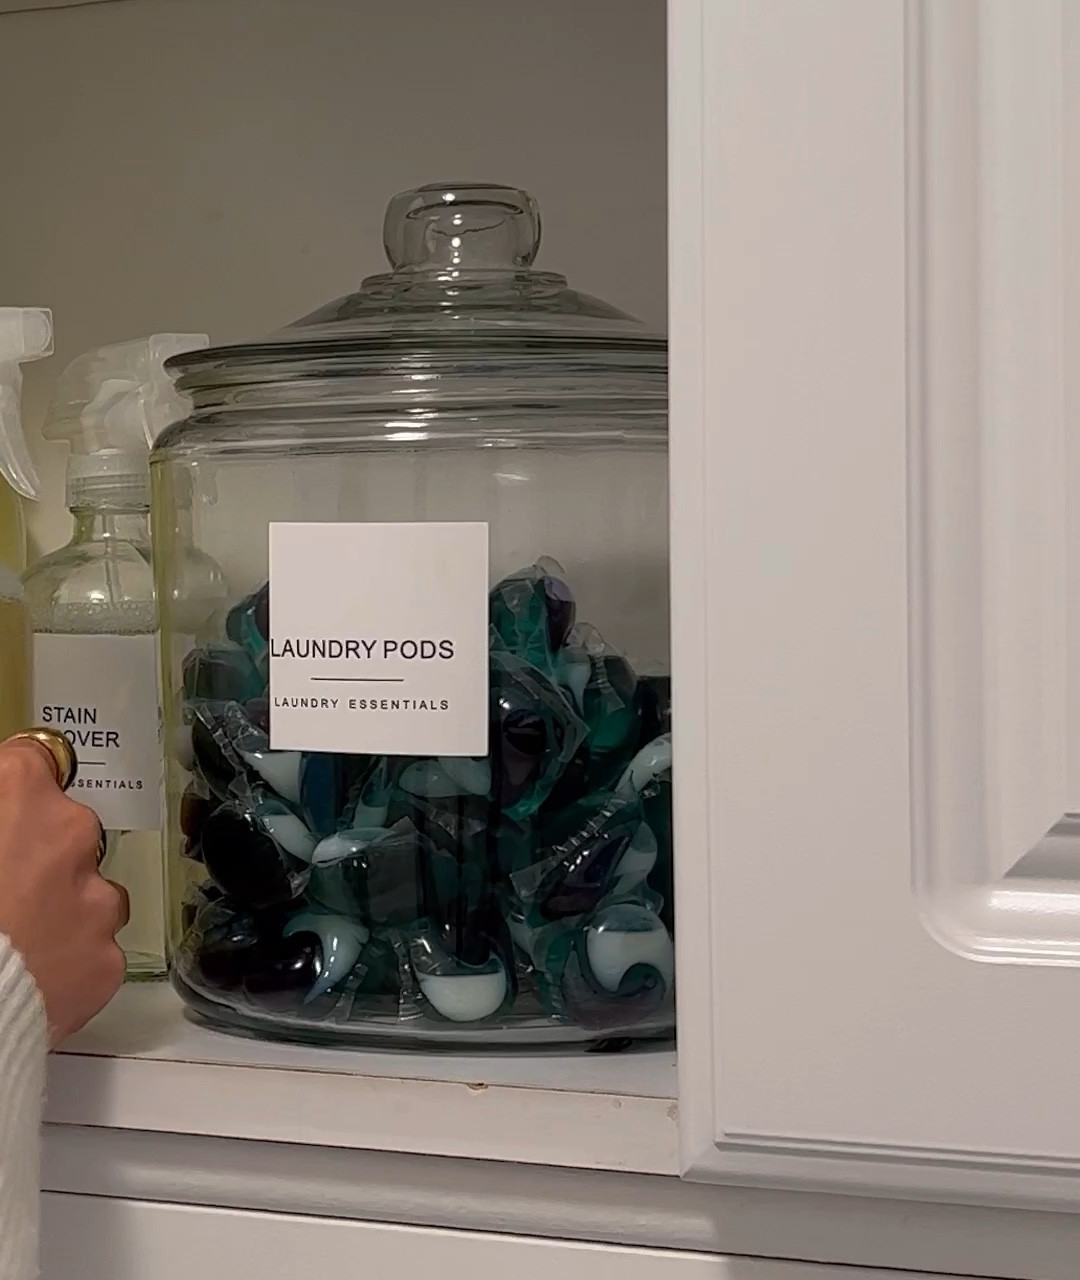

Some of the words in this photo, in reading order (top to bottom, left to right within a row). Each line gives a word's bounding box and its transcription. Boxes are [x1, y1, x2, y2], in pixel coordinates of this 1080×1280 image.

[271, 638, 377, 659] LAUNDRY
[383, 639, 455, 660] PODS
[274, 697, 339, 709] LAUNDRY
[349, 699, 449, 710] ESSENTIALS
[42, 706, 97, 724] STAIN
[63, 729, 120, 748] OVER
[70, 778, 143, 790] SENTIALS
